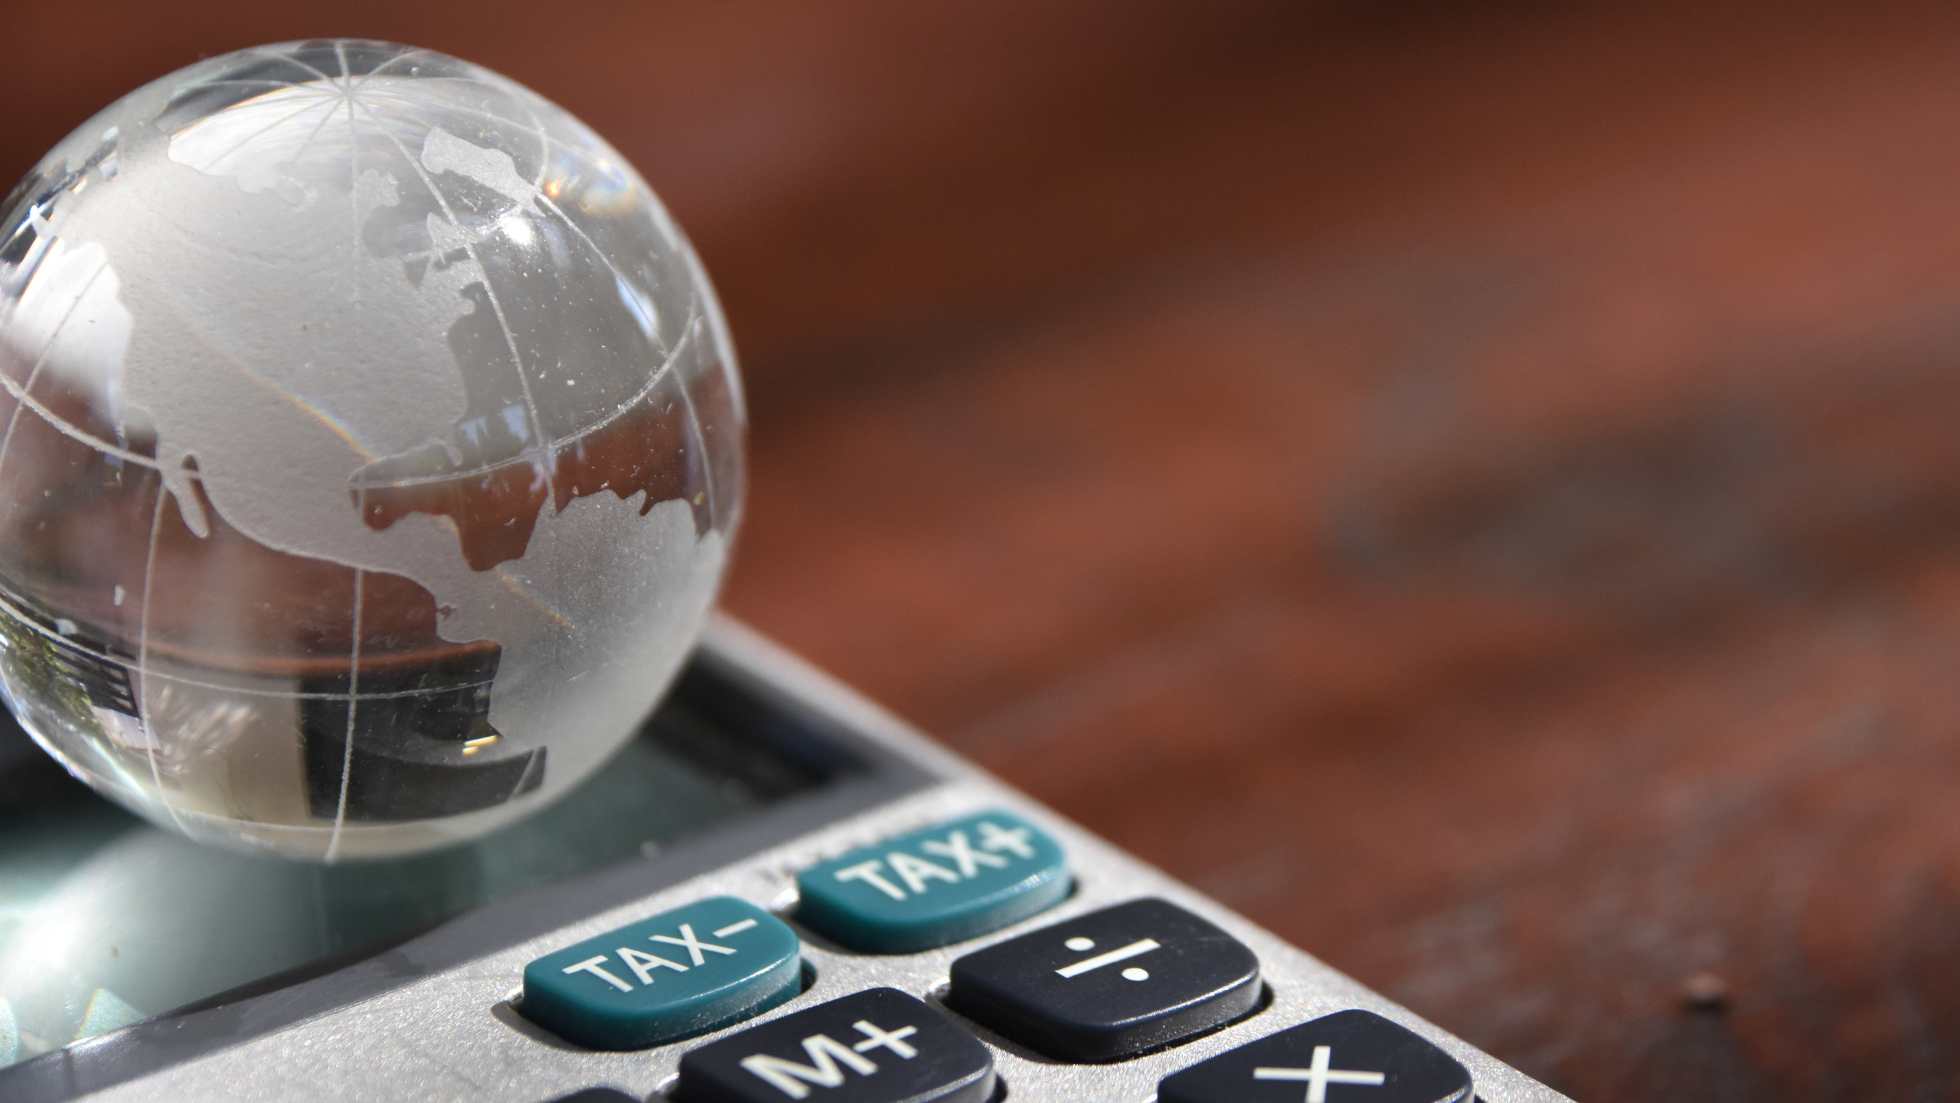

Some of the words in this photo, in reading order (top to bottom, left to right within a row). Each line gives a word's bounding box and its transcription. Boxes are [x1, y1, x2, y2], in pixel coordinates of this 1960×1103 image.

[835, 819, 1035, 900] TAX+
[562, 918, 759, 992] TAX-
[740, 1019, 918, 1099] M+
